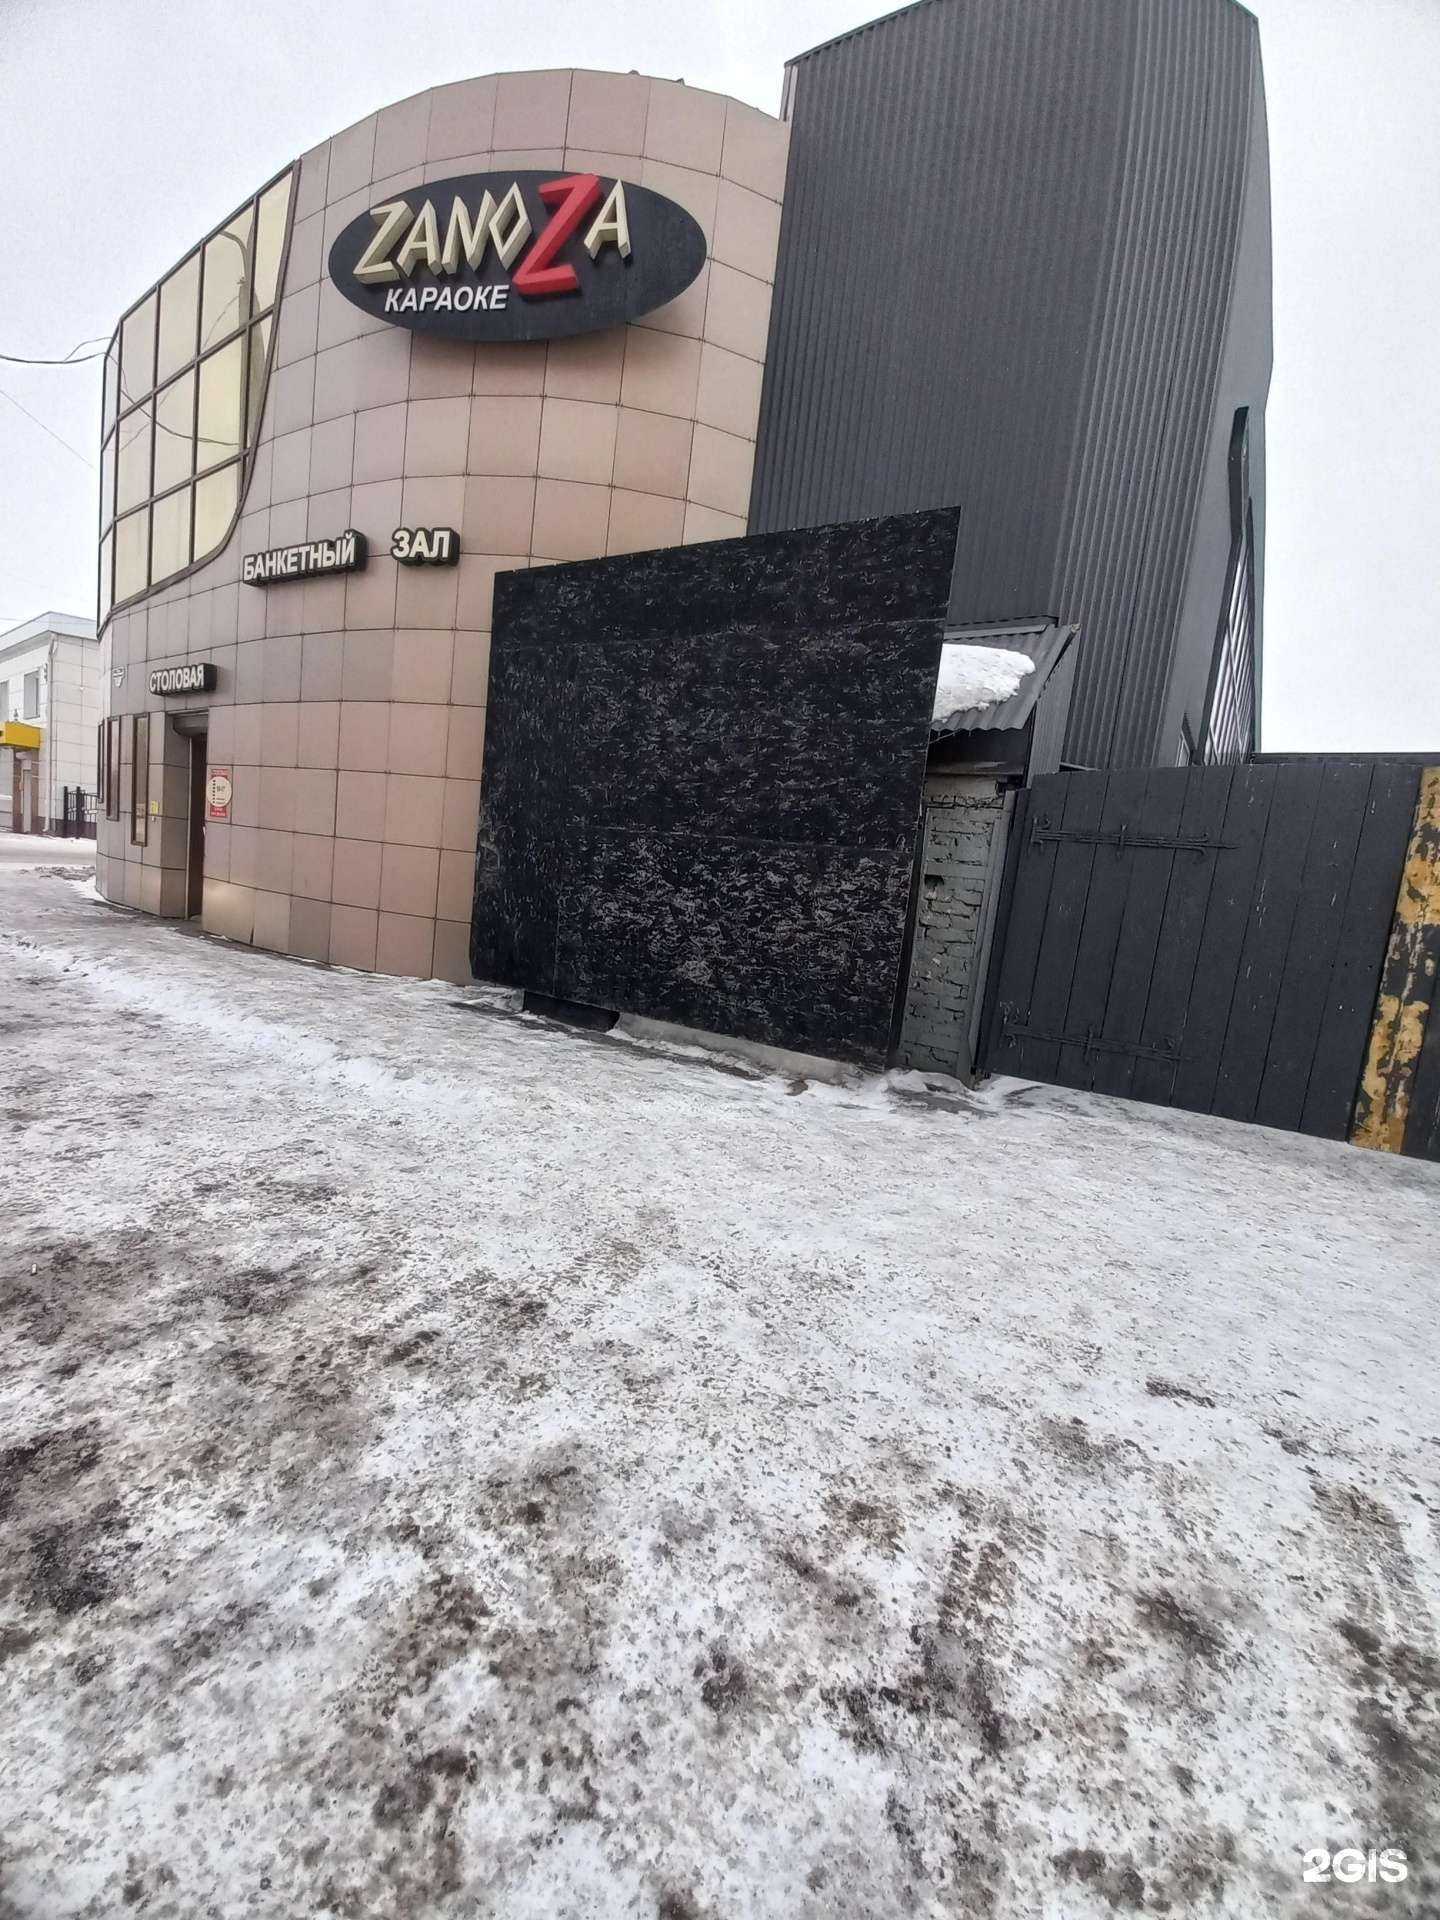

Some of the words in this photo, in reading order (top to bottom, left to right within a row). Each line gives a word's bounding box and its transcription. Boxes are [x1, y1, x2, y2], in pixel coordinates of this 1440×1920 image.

[384, 285, 510, 312] КАРАОКЕ
[243, 533, 355, 581] БАНКЕТНЫЙ
[392, 530, 451, 558] ЗАЛ
[150, 664, 204, 692] СТОЛОВАЯ
